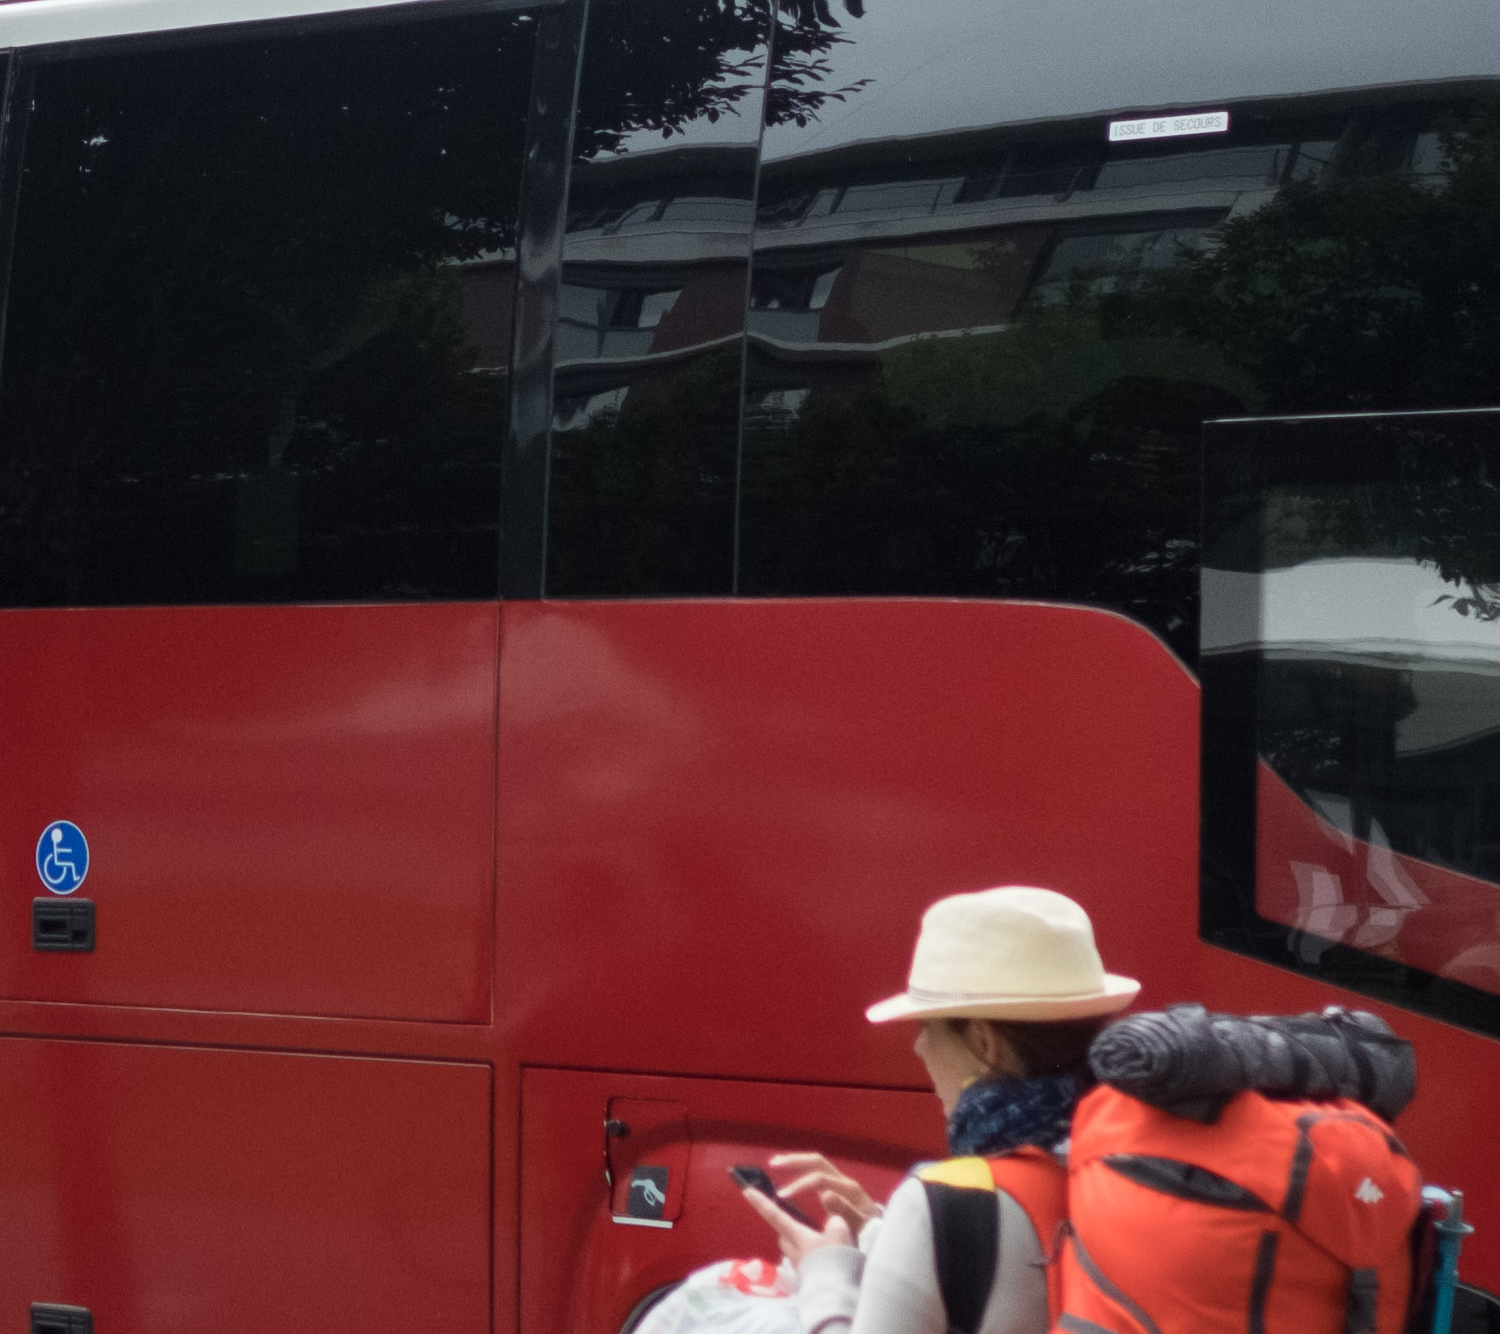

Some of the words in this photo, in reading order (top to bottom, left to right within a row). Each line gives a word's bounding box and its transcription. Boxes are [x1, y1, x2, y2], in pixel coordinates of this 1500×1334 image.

[1113, 123, 1145, 137] ISSUE
[1152, 121, 1167, 133] DE
[1172, 116, 1222, 132] SECOURS
